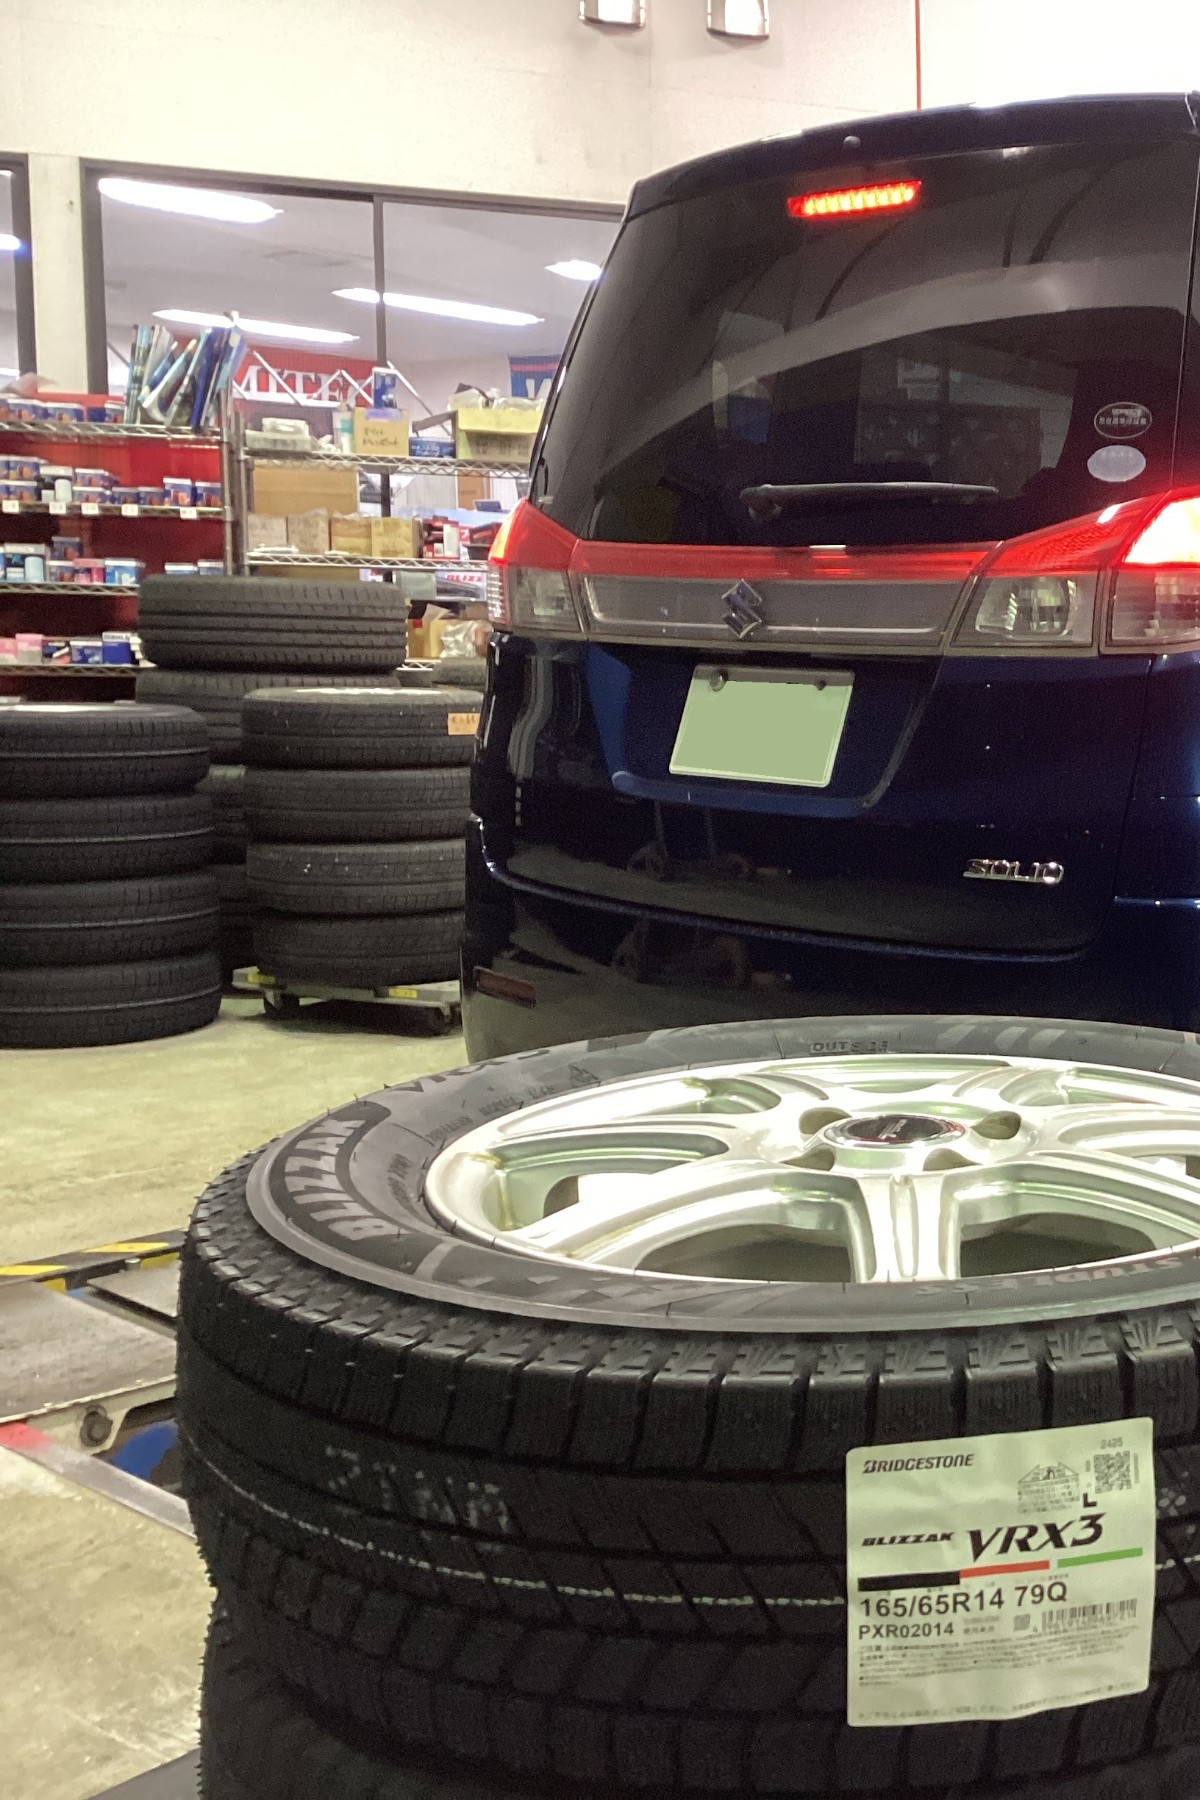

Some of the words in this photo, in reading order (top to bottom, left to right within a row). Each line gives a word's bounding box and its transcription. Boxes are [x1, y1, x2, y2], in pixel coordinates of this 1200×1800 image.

[963, 858, 1065, 884] SOLIO
[284, 1119, 413, 1242] BLIZZAK
[862, 1453, 976, 1474] BRIDGESTONE
[1083, 1492, 1098, 1508] L
[861, 1532, 955, 1547] BLIZZAK
[966, 1512, 1107, 1563] VRX3
[859, 1587, 1004, 1618] 165/65R14
[1014, 1581, 1068, 1607] 79Q
[858, 1622, 954, 1640] PXR02014
